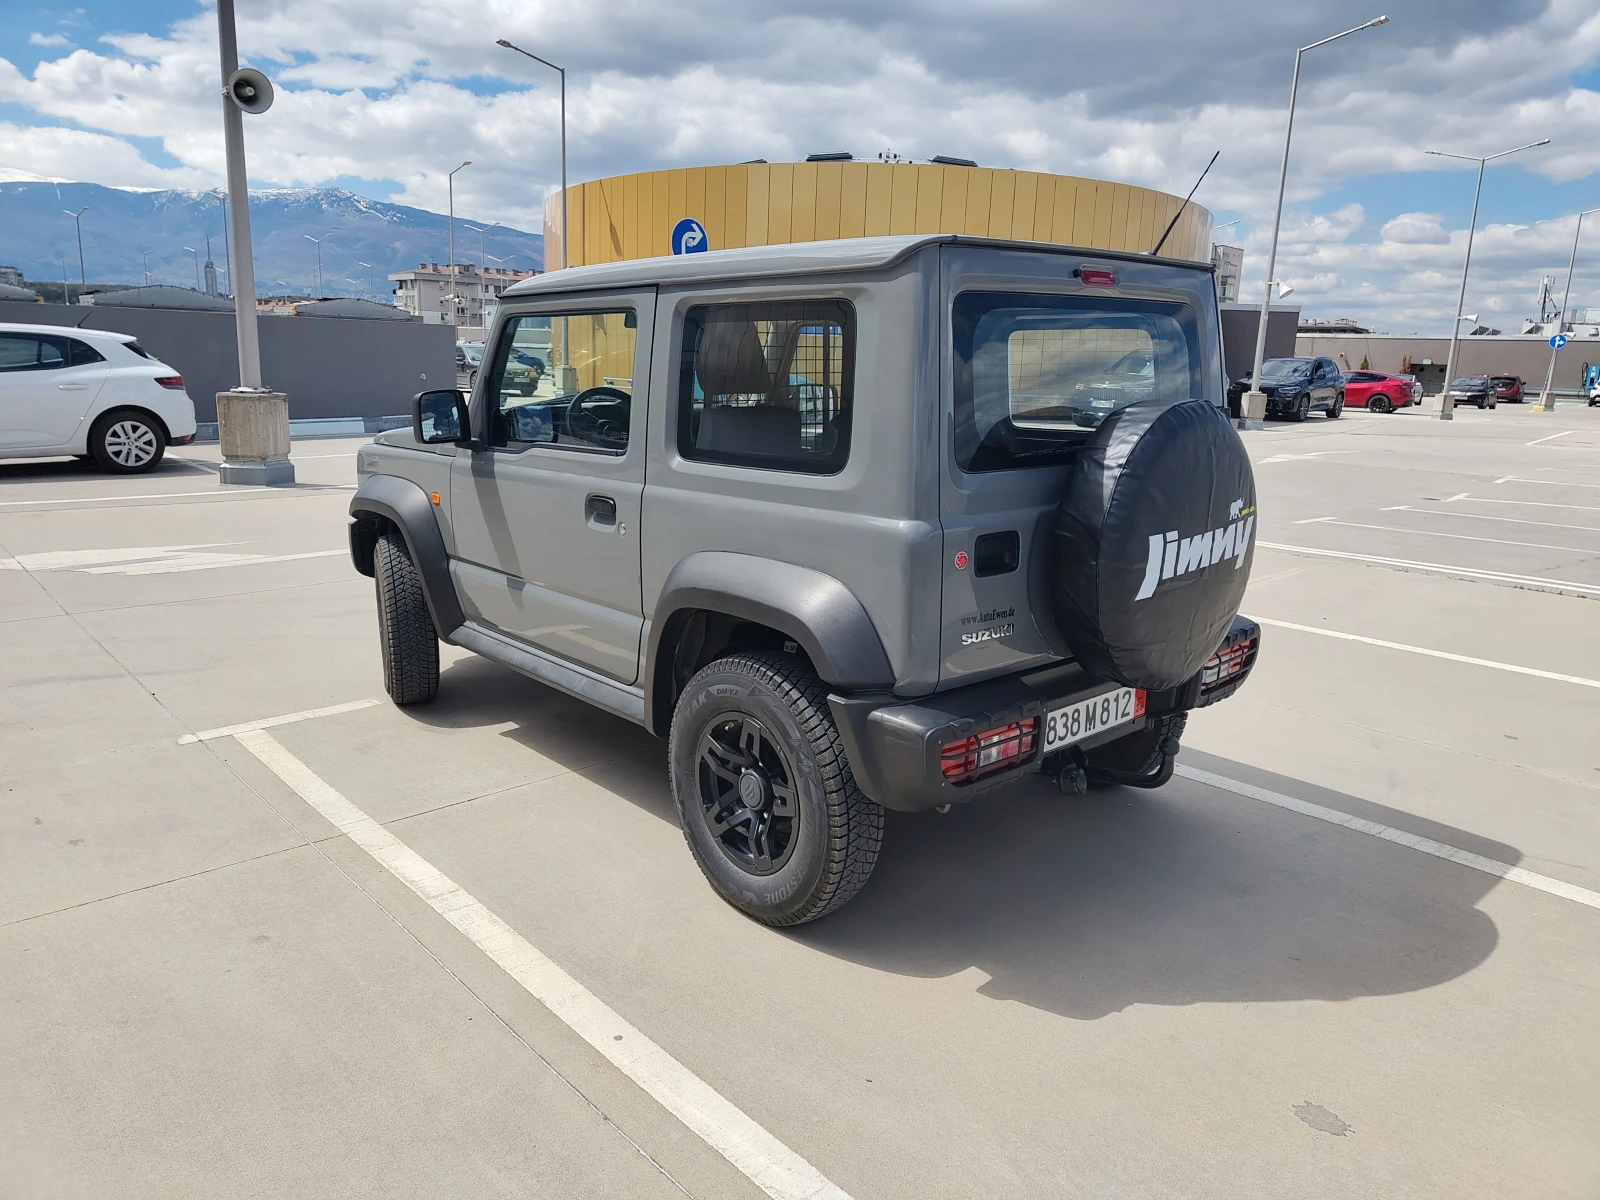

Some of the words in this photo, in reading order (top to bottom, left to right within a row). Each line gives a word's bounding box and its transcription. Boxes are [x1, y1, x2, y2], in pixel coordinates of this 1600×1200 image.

[1135, 515, 1255, 601] Jimny
[961, 623, 1015, 645] SUZUKI
[1047, 708, 1081, 745] 838
[1100, 690, 1132, 726] 812
